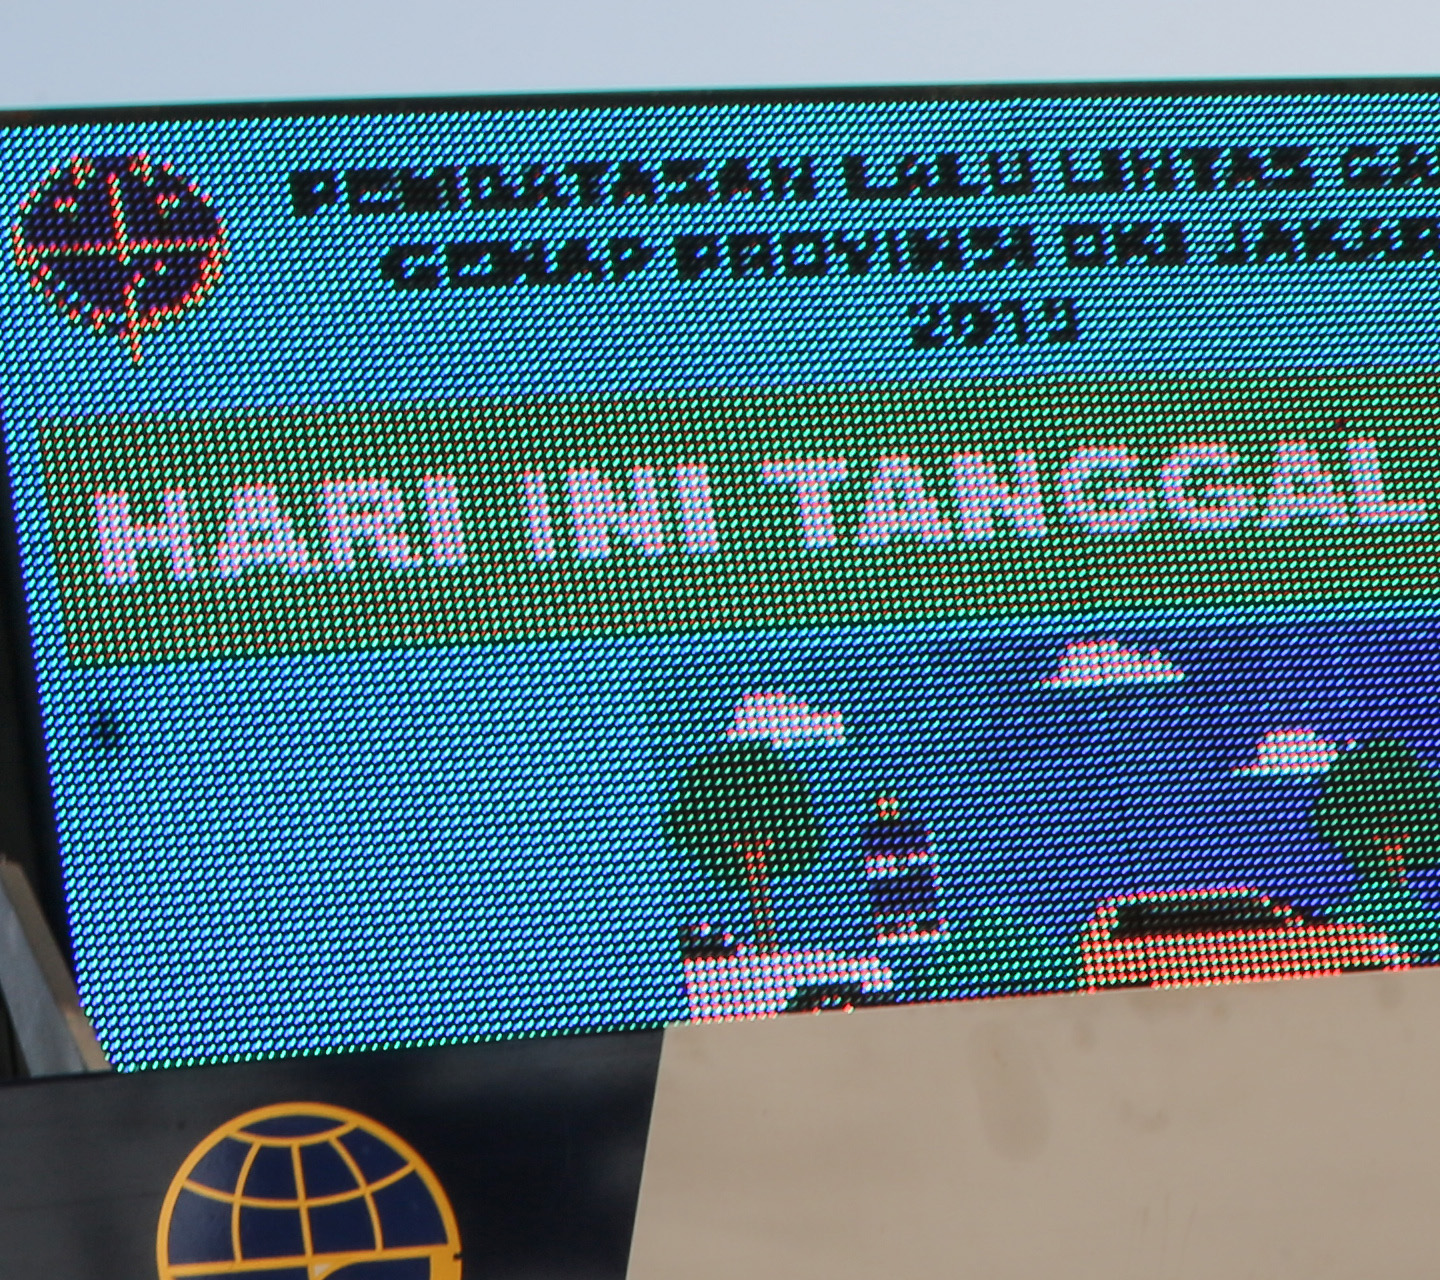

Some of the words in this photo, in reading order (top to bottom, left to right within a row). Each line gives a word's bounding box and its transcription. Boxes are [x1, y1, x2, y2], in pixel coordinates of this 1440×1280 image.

[842, 148, 1034, 200] LALU
[92, 473, 469, 588] HARI
[520, 461, 719, 565] INI
[760, 437, 1427, 552] TANGGAL
